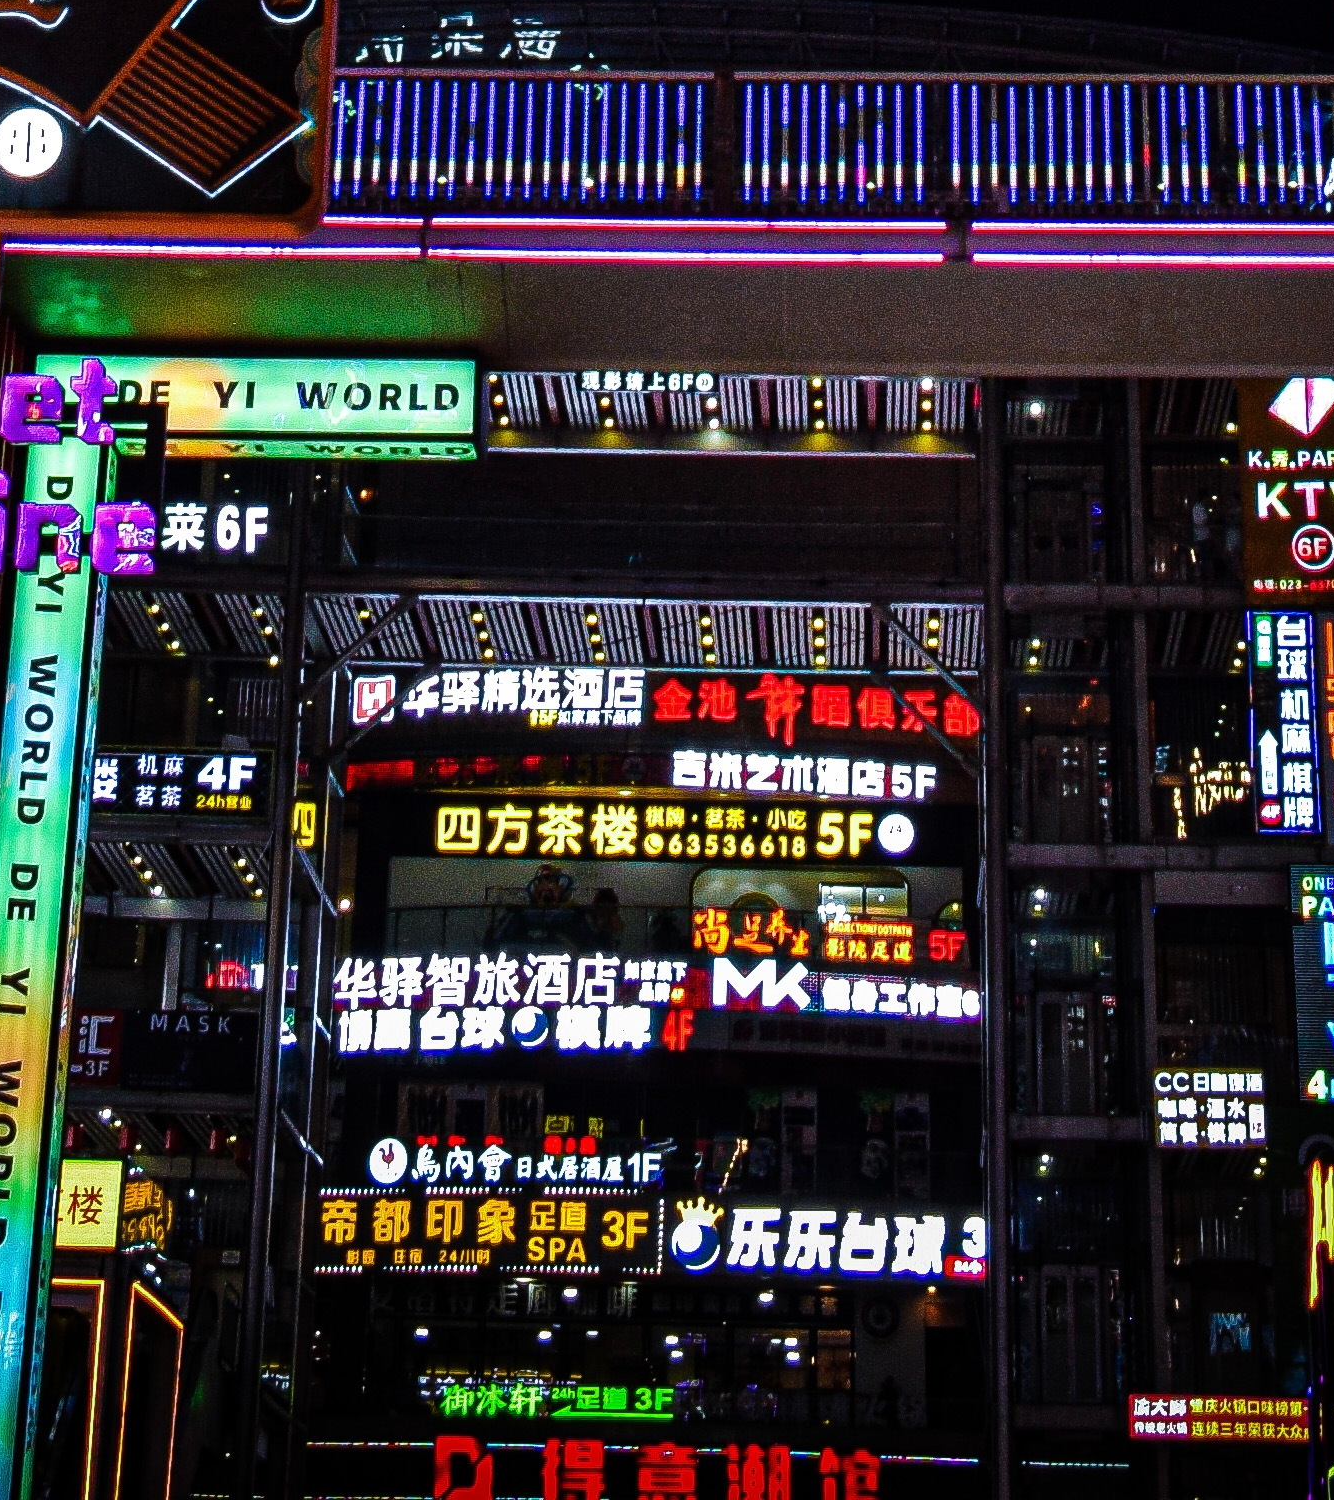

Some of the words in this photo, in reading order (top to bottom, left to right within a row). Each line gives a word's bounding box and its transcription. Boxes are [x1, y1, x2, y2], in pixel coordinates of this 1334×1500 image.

[215, 381, 256, 410] YI
[297, 380, 460, 411] WORLD
[163, 505, 204, 552] 菜
[216, 505, 269, 553] 6F
[1297, 538, 1327, 558] 6F
[1277, 616, 1307, 681] 台球
[4, 653, 59, 826] WORLD
[1281, 688, 1311, 754] 机麻
[137, 756, 184, 778] 机麻
[197, 757, 257, 791] 4F
[891, 765, 937, 799] 5F
[1283, 762, 1315, 829] 棋牌
[436, 803, 639, 854] 四方茶楼
[668, 834, 807, 858] 63536618
[817, 812, 873, 857] 5F
[7, 863, 38, 921] DE
[1303, 877, 1334, 893] ONE
[929, 931, 965, 960] 5F
[334, 953, 620, 1009] 华驿智旅酒店
[712, 958, 812, 1010] MK
[662, 1011, 693, 1051] 4F
[627, 1152, 662, 1183] 1F
[321, 1199, 517, 1244] 帝都印象
[602, 1211, 649, 1250] 3F
[727, 1206, 946, 1276] 乐乐台球
[528, 1237, 587, 1262] SPA
[634, 1387, 673, 1410] 3F
